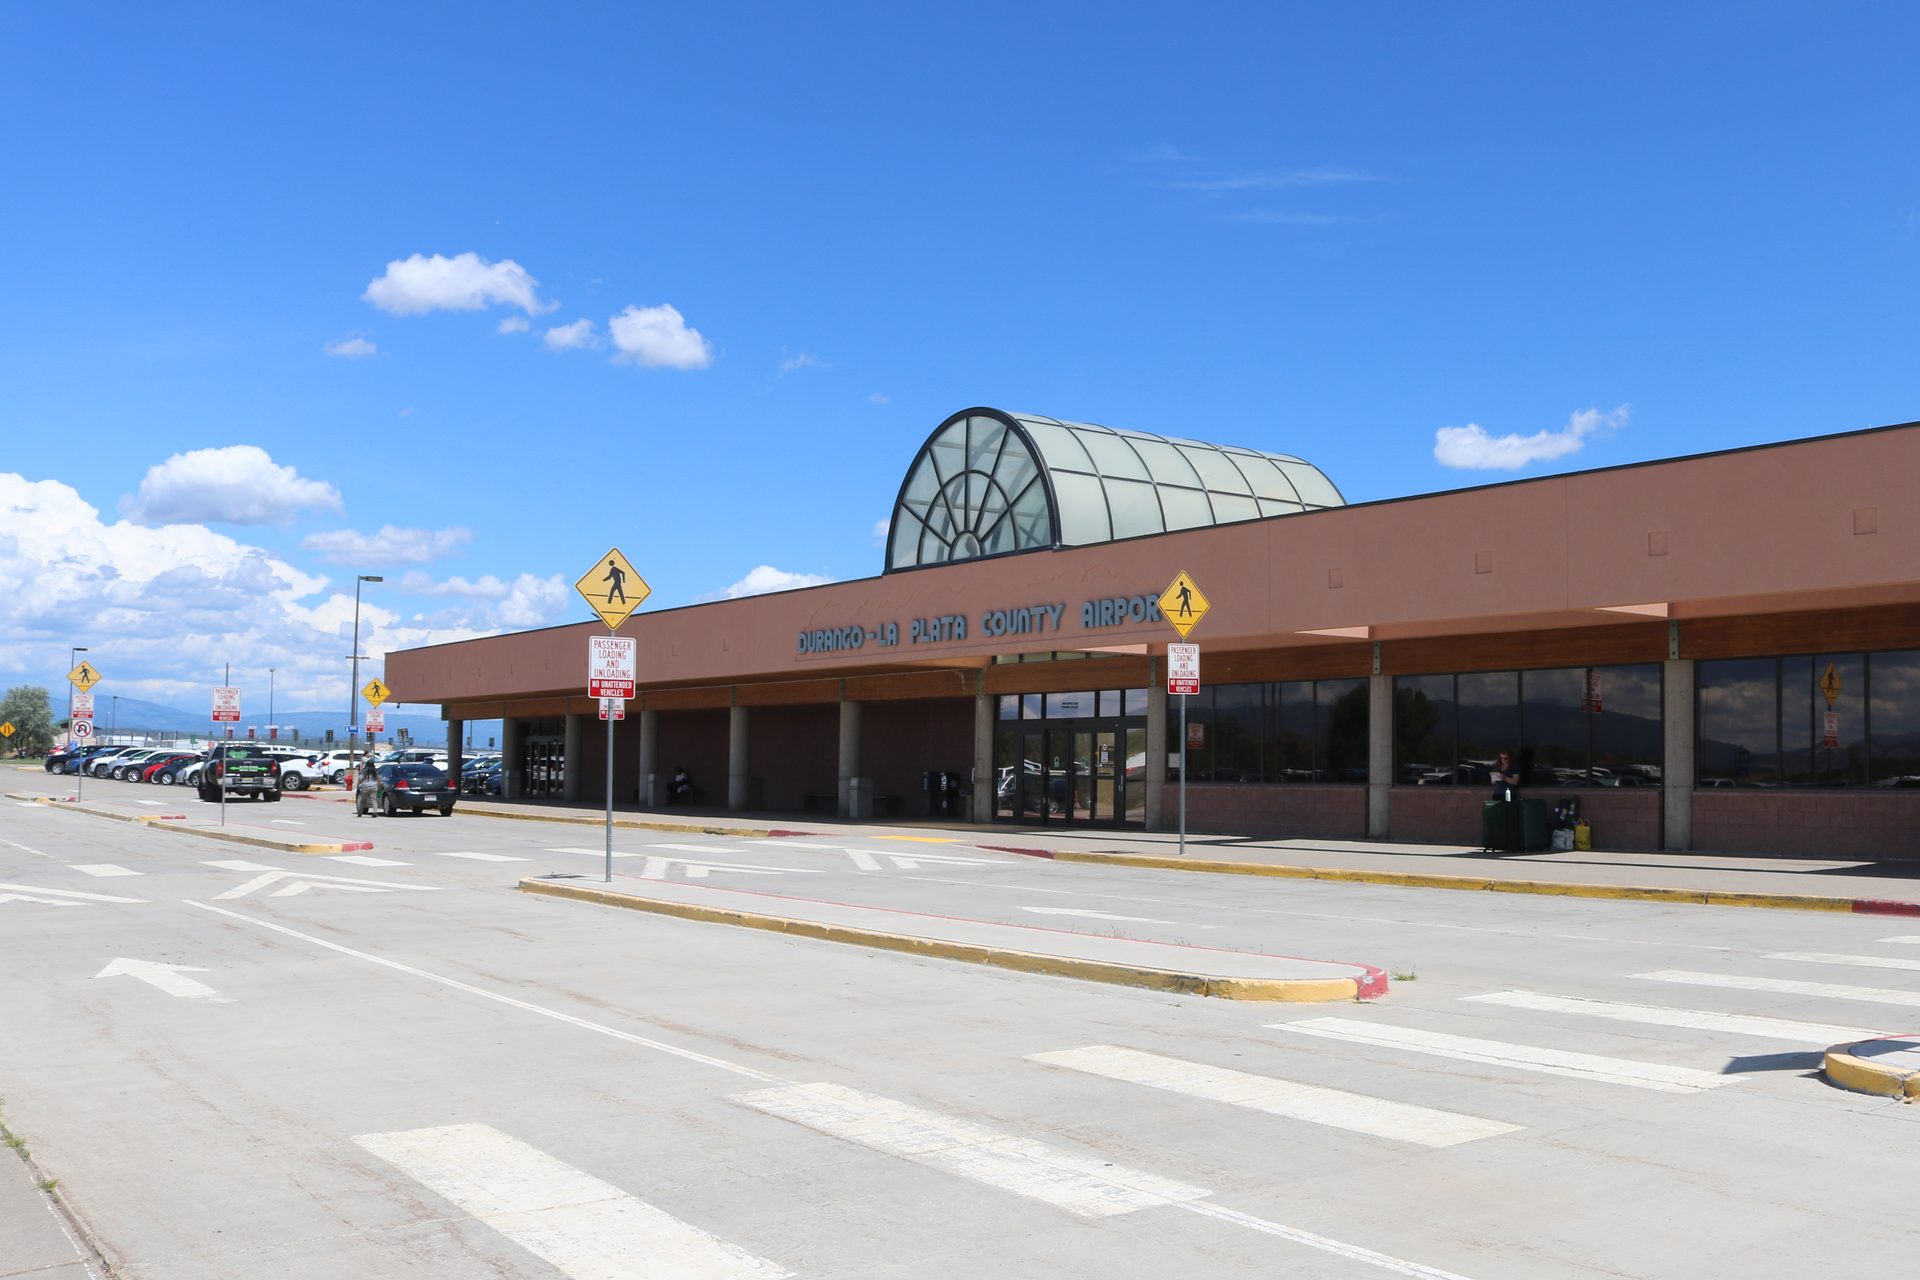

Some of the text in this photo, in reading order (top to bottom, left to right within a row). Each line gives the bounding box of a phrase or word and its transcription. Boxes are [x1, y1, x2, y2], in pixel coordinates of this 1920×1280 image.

[910, 615, 967, 643] PLATA
[981, 603, 1066, 637] COUNTY
[1082, 594, 1162, 629] AIRPOR
[594, 640, 631, 650] PASSENGER
[599, 650, 626, 659] LOADING
[1174, 654, 1193, 662] LOADING
[606, 660, 619, 668] AND
[594, 669, 631, 679] UNLOADING
[601, 681, 632, 689] UNATTENDED
